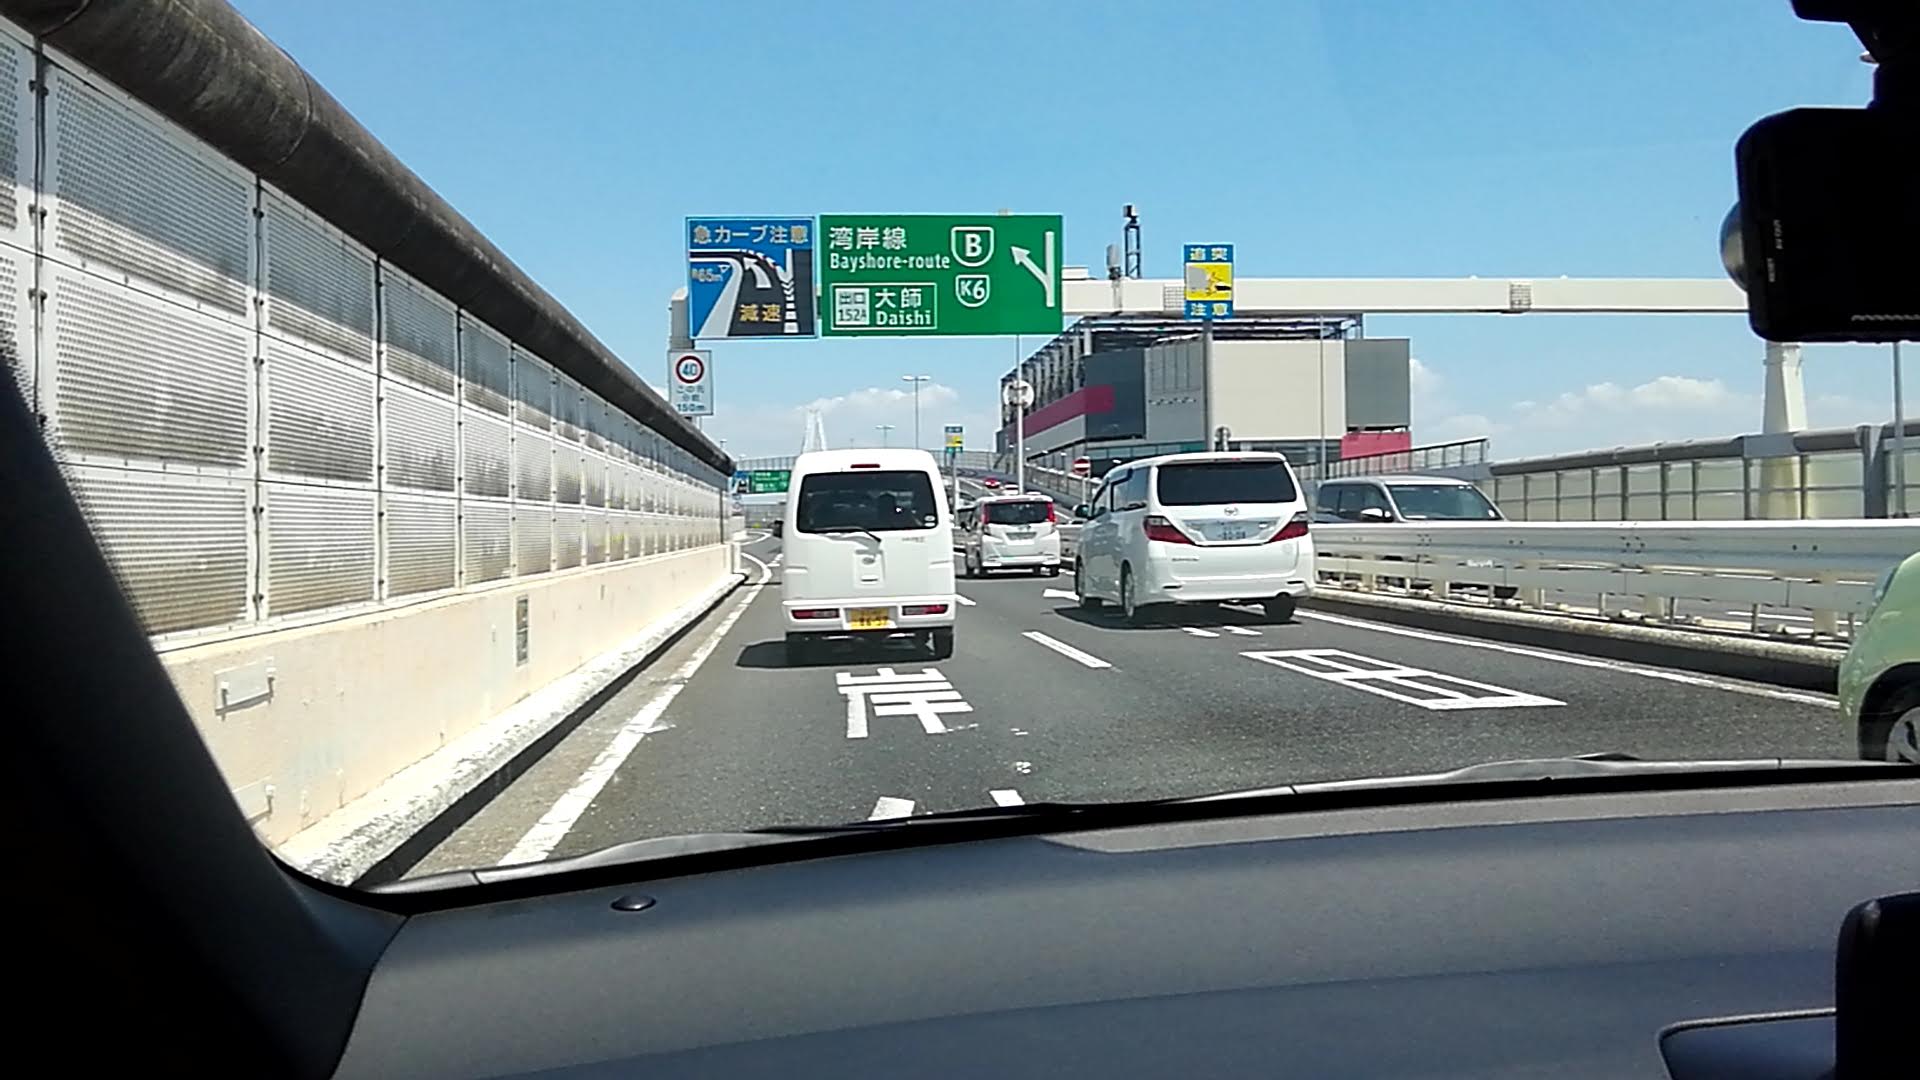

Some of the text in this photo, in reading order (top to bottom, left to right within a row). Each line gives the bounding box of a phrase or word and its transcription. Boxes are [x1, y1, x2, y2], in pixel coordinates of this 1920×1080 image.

[693, 225, 809, 245] 急カーブ注意
[829, 226, 907, 250] 湾岸線
[965, 233, 982, 257] B
[1190, 247, 1228, 261] 追突
[830, 252, 951, 273] Bayshore-route
[838, 291, 866, 305] 出口
[874, 287, 922, 308] 大師
[960, 280, 985, 300] K6
[739, 303, 781, 322] 減速
[876, 310, 931, 325] Daishi
[1190, 303, 1229, 316] 注意
[682, 362, 698, 376] 40
